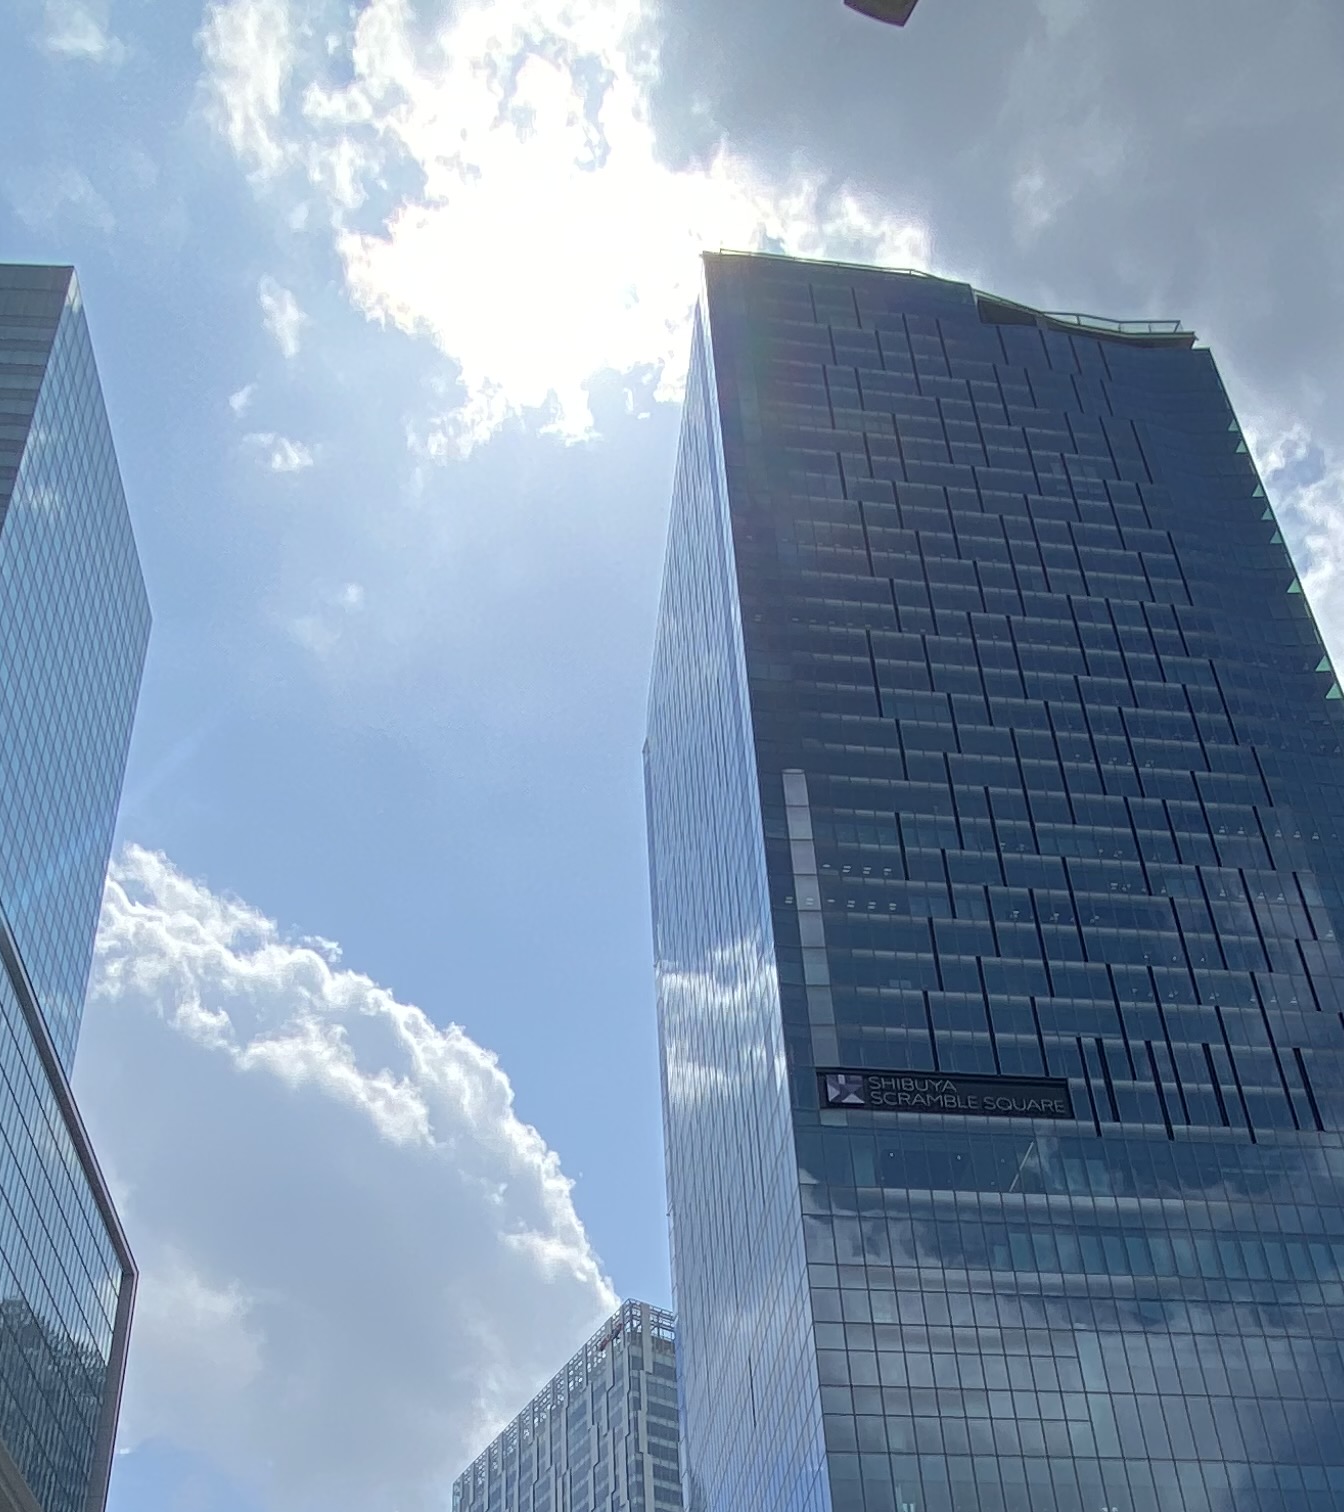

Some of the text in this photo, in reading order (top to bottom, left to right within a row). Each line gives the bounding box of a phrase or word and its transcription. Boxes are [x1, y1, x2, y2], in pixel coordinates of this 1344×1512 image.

[868, 1076, 957, 1093] SHIBUYA
[870, 1091, 1067, 1113] SCRAMBLE SQUARE
